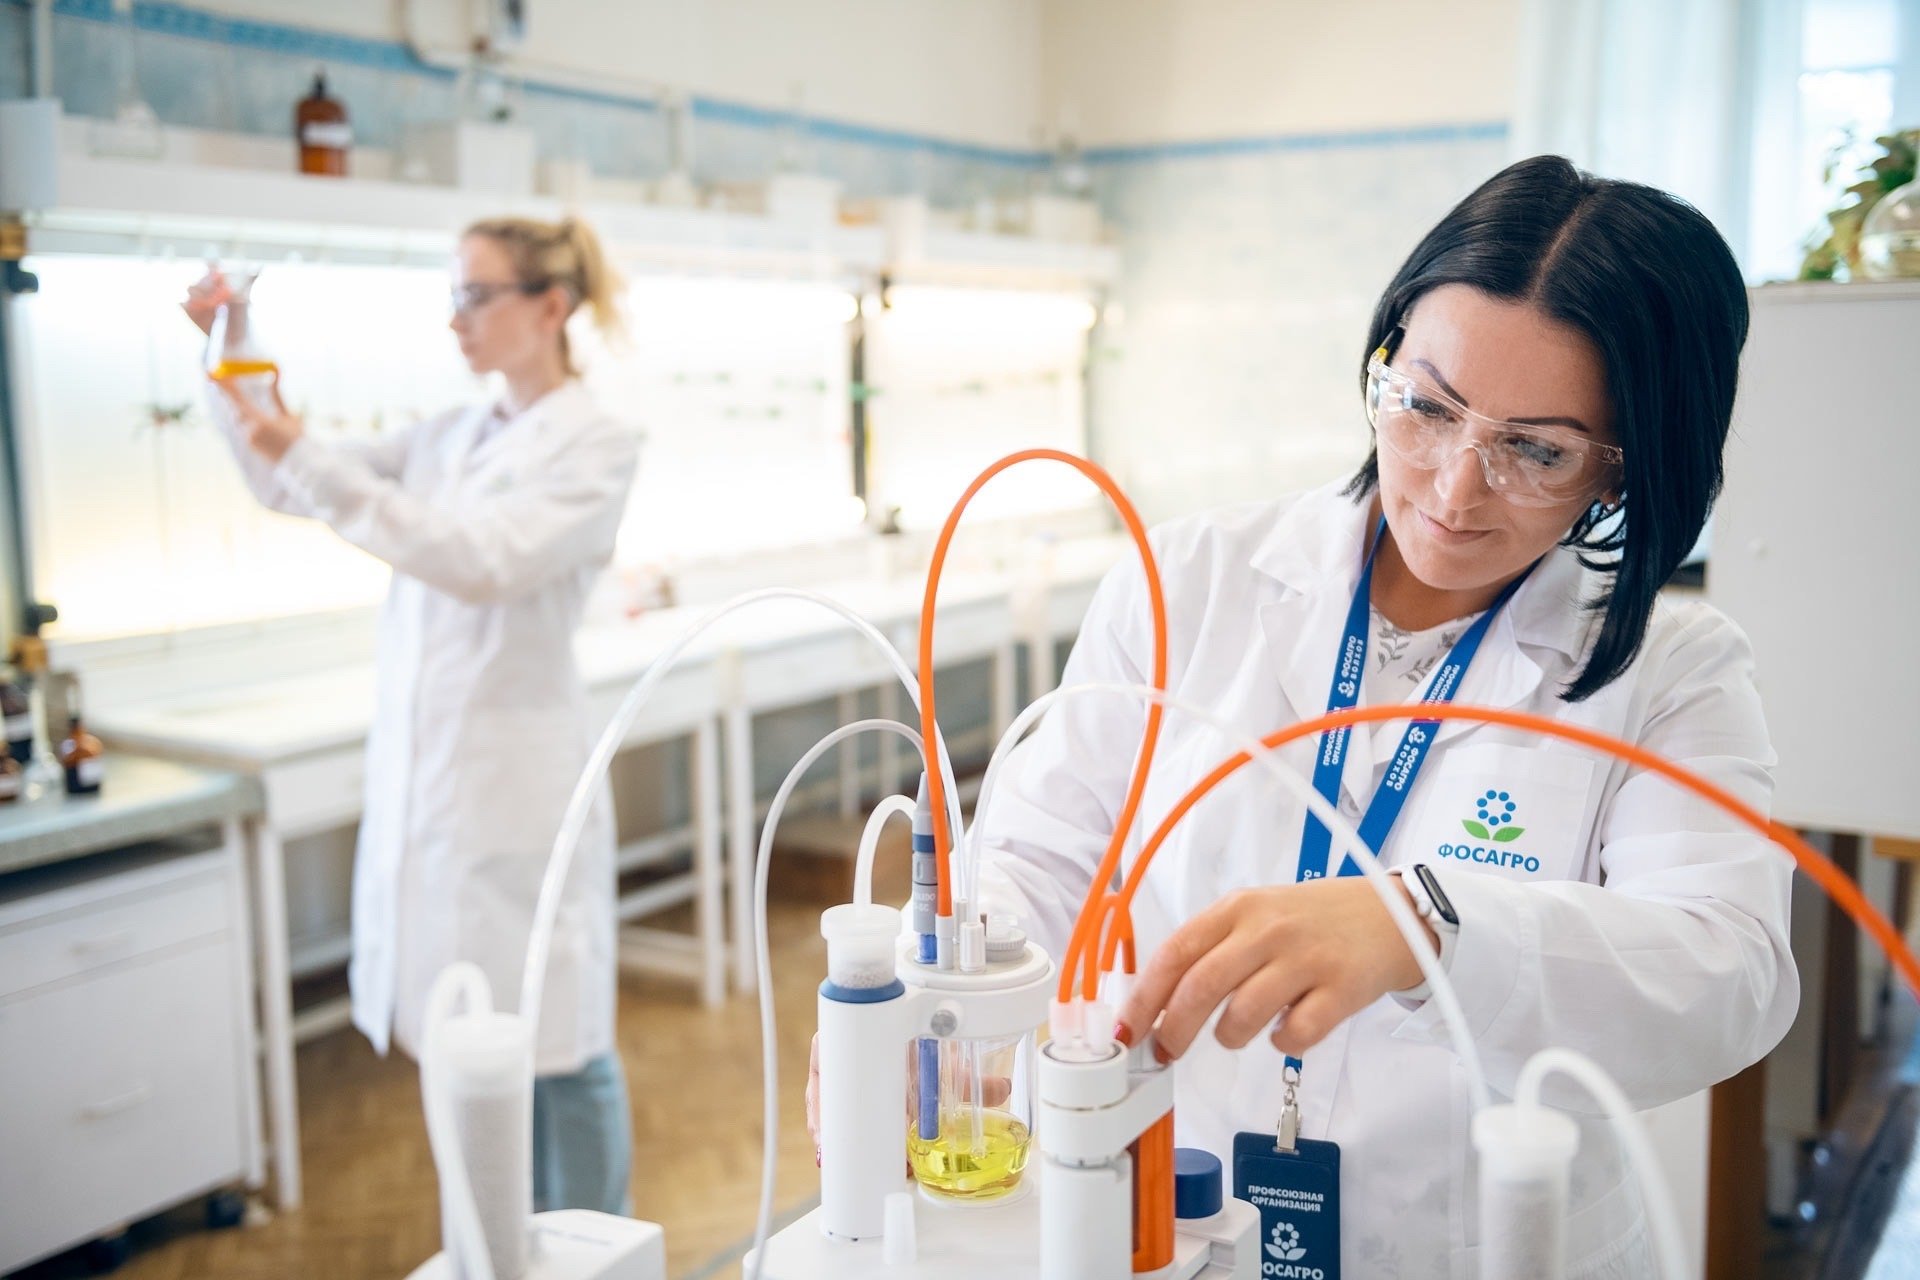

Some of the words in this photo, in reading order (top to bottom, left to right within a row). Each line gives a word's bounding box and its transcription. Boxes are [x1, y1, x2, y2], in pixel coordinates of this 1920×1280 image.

[1341, 635, 1357, 678] ФОСАГРО
[1350, 639, 1364, 680] ВОЛХОВ
[1386, 743, 1411, 788] ВОЛХОВ
[1394, 747, 1419, 791] ФОСАГРО
[1438, 843, 1540, 873] ФОСАГРО
[1248, 1185, 1324, 1202] ПРОФСОЮЗНАЯ
[1251, 1196, 1321, 1212] ОРГАНИЗАЦИЯ
[1262, 1261, 1324, 1280] ОСАГРО
